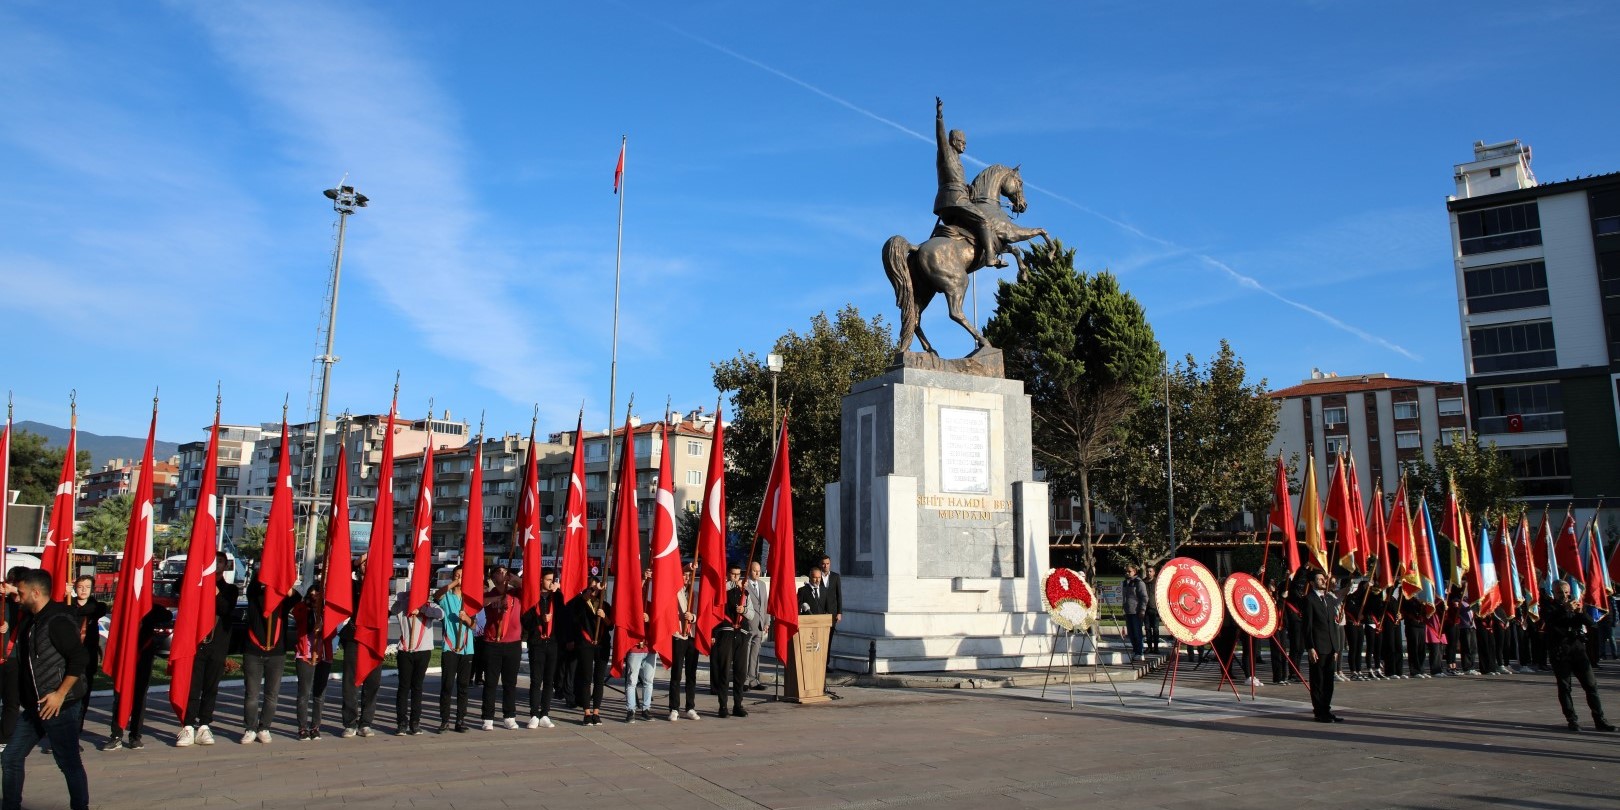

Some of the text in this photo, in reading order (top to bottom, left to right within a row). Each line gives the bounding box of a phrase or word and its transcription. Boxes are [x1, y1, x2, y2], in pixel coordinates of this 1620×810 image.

[948, 497, 985, 508] HAMDİ
[993, 499, 1013, 510] BEY
[938, 510, 991, 520] MEYDANI
